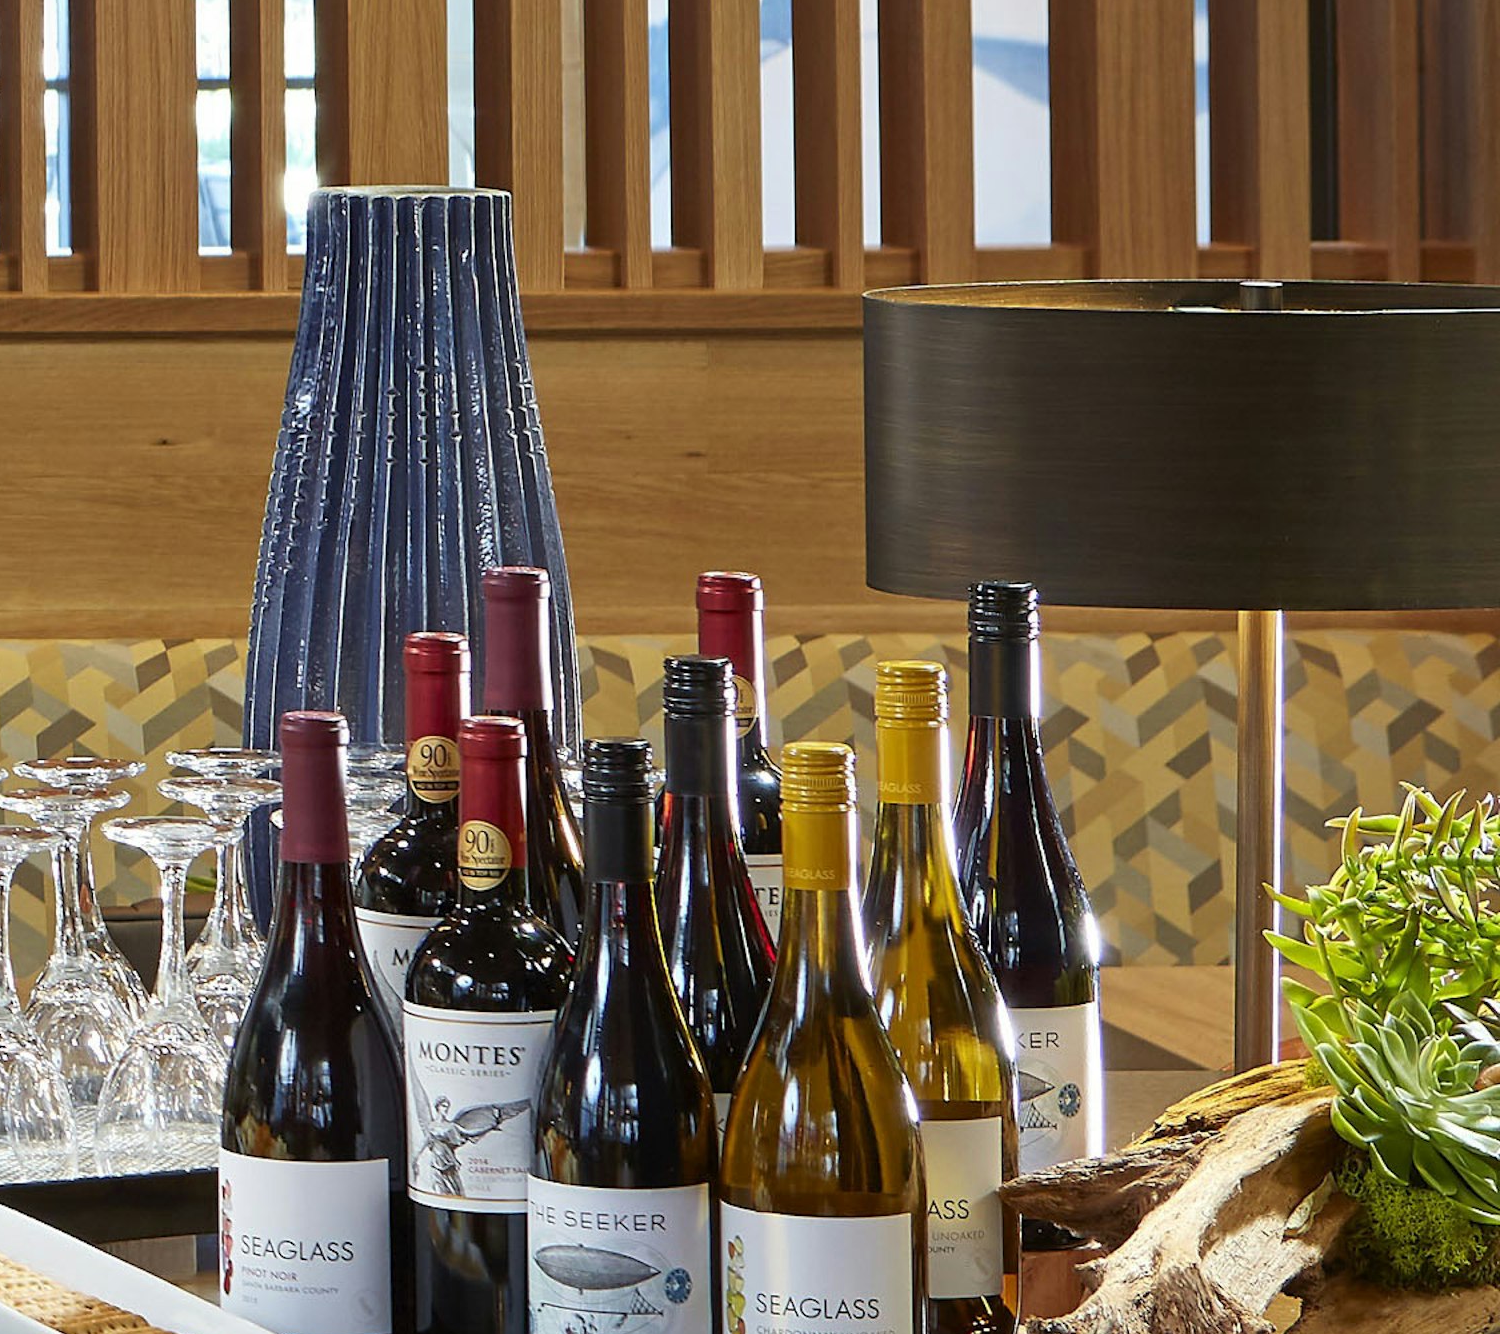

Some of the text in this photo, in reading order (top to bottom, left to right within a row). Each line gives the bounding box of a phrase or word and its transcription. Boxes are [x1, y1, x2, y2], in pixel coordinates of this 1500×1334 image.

[420, 744, 447, 768] 90
[465, 828, 490, 855] 90
[419, 1040, 521, 1066] MONTES
[564, 1209, 666, 1232] SEEKER
[241, 1234, 355, 1262] SEAGLASS
[928, 1246, 956, 1254] OUNTY
[756, 1293, 880, 1319] SEAGLASS
